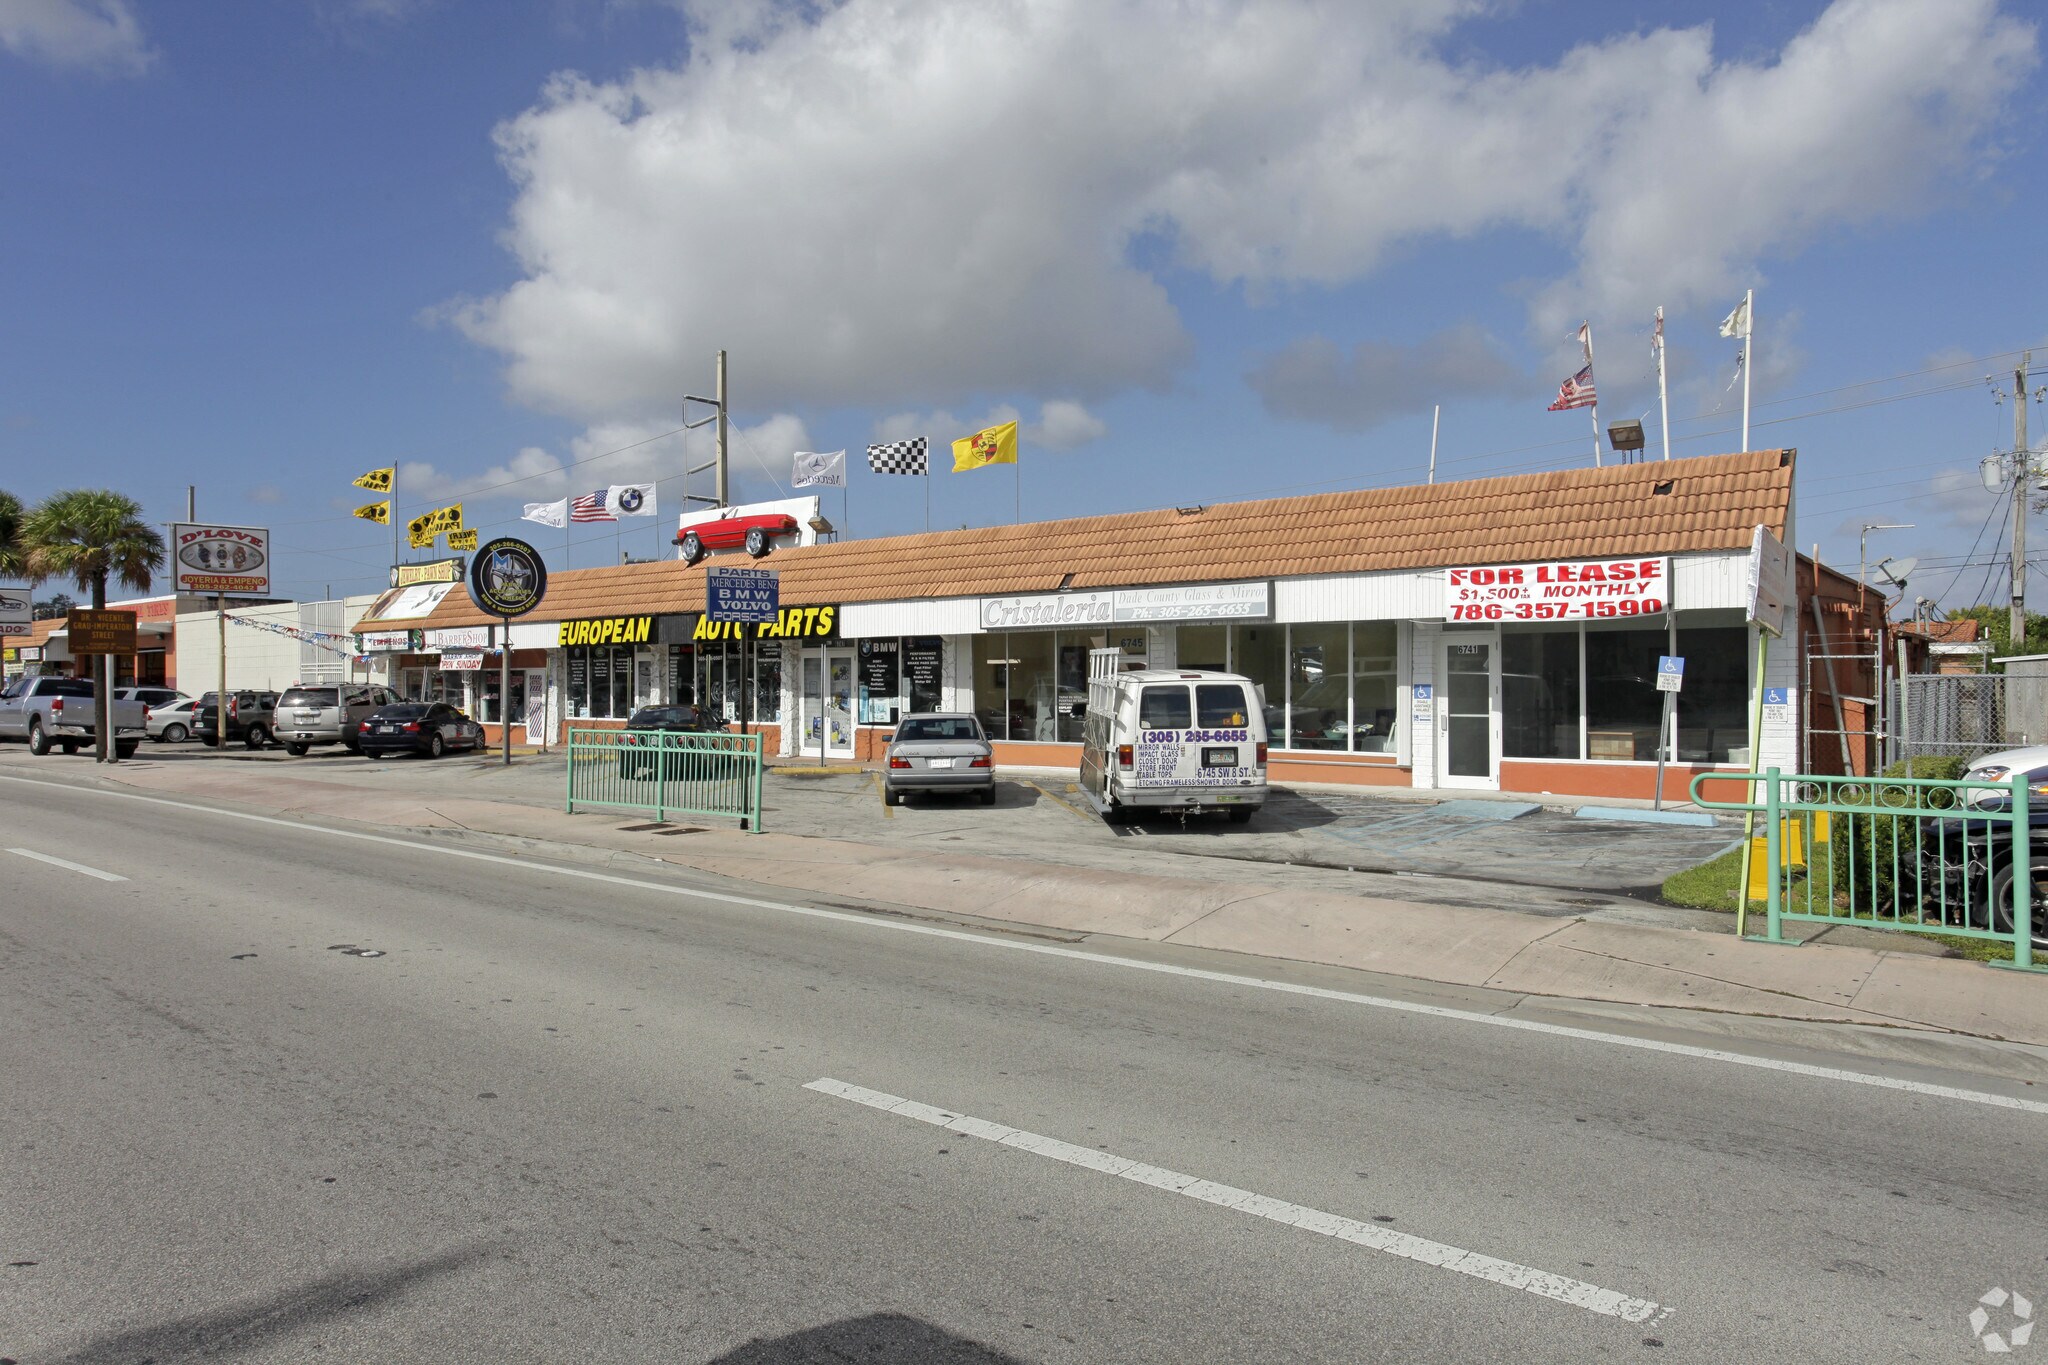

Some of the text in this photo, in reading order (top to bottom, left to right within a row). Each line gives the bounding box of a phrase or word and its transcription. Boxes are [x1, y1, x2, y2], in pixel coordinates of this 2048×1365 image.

[179, 529, 264, 548] D'LOVE
[719, 568, 771, 578] PARTS
[1450, 560, 1662, 586] FOR LEASE
[183, 576, 219, 584] JOYERIA
[711, 577, 778, 590] MERCEDES BENZ
[193, 583, 255, 591] 305-262-4042
[1543, 581, 1651, 598] MONTHLY
[1118, 585, 1267, 605] Dade County Glass & Mirror
[718, 600, 772, 611] VOLVO
[983, 594, 1111, 627] Cristaleria
[1158, 602, 1252, 619] 305-265-6655
[1450, 598, 1663, 620] 786-357-1590
[713, 611, 776, 622] PORSCHE
[757, 606, 835, 639] PARTS
[91, 631, 115, 639] STREET
[558, 616, 652, 646] EUROPEAN
[873, 642, 898, 653] BMW
[1120, 638, 1143, 648] 6745
[1458, 645, 1478, 654] 6741
[1142, 729, 1248, 743] (305) 265-6655
[1162, 743, 1180, 751] WALLS
[1197, 767, 1251, 779] 6745 SW 8 ST.
